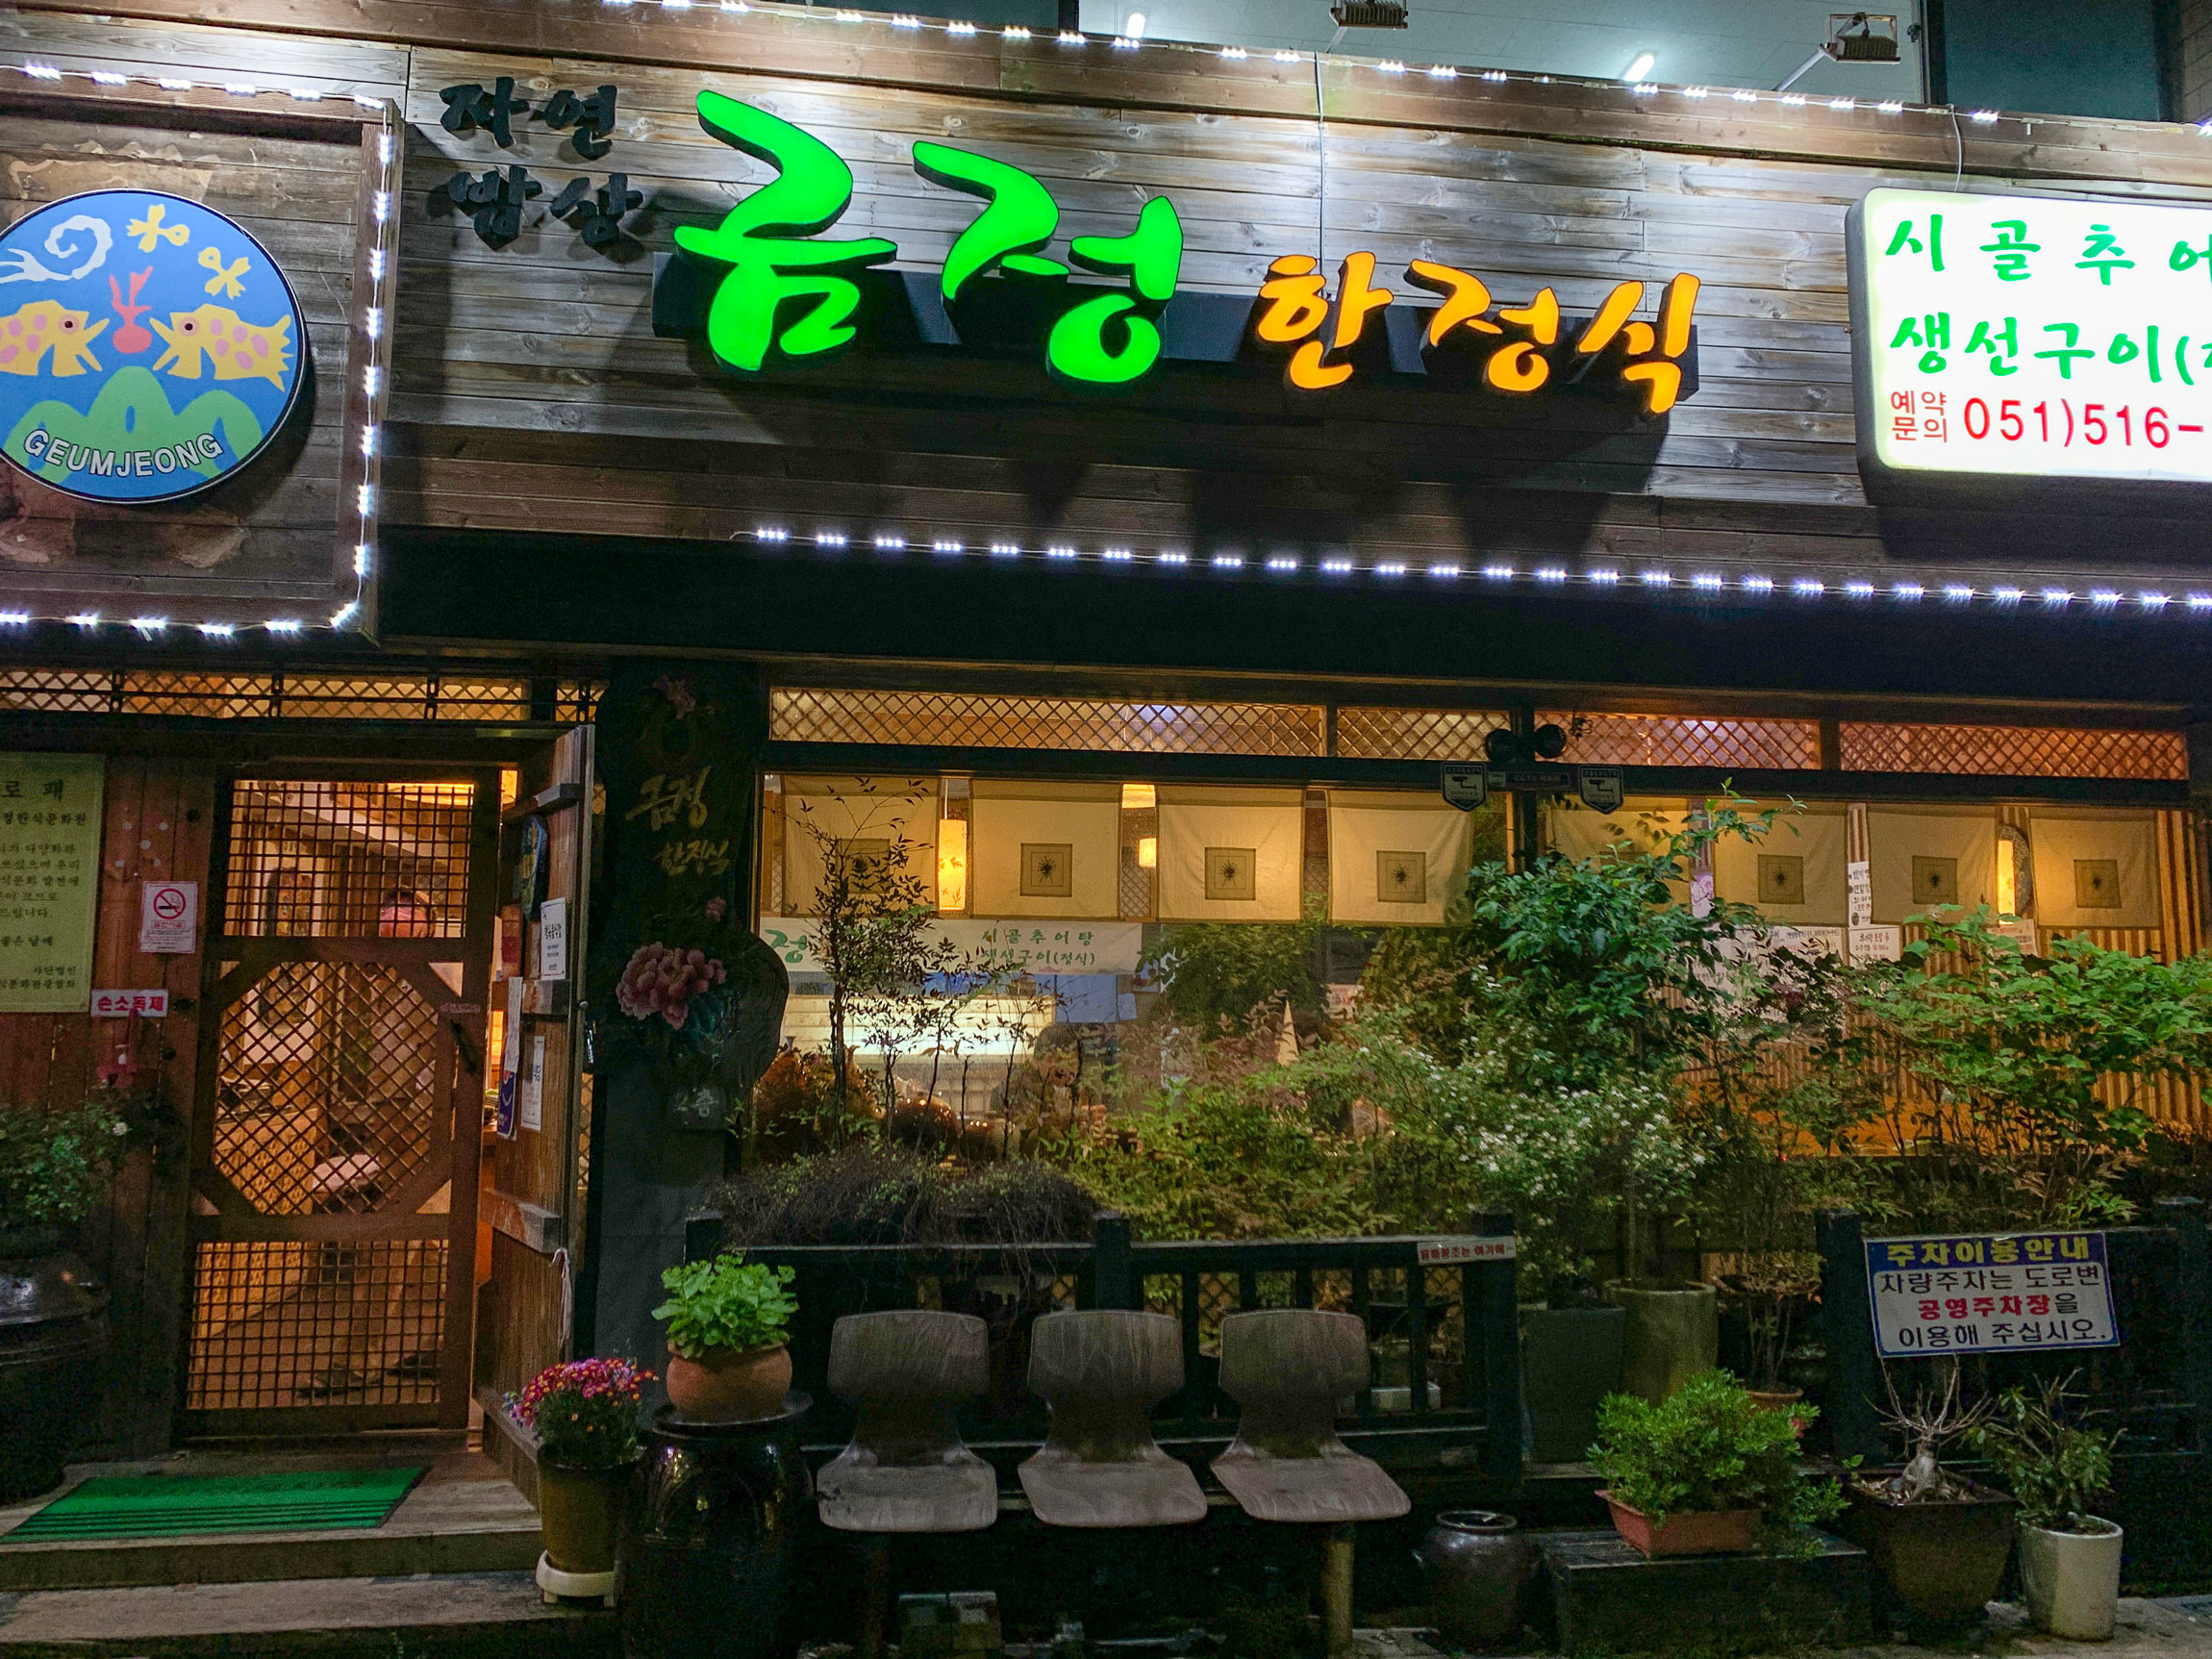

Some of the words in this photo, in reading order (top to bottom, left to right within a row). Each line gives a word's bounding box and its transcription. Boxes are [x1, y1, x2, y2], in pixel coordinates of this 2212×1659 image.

[440, 76, 618, 161] 자연
[448, 164, 645, 253] 밥상
[673, 89, 1184, 385] 금정
[1258, 250, 1700, 415] 한정식
[1890, 390, 1948, 416] 예약
[1891, 416, 1948, 443] 문의
[23, 429, 224, 478] GEUMJEONG
[1887, 1236, 2090, 1268] 주차이용안내
[1880, 1269, 2013, 1295] 차량주차는
[2024, 1264, 2101, 1288] 도로변
[1918, 1292, 2079, 1320] 공영주차장을
[1898, 1323, 1979, 1348] 이용해
[1991, 1318, 2106, 1345] 주십시오.
